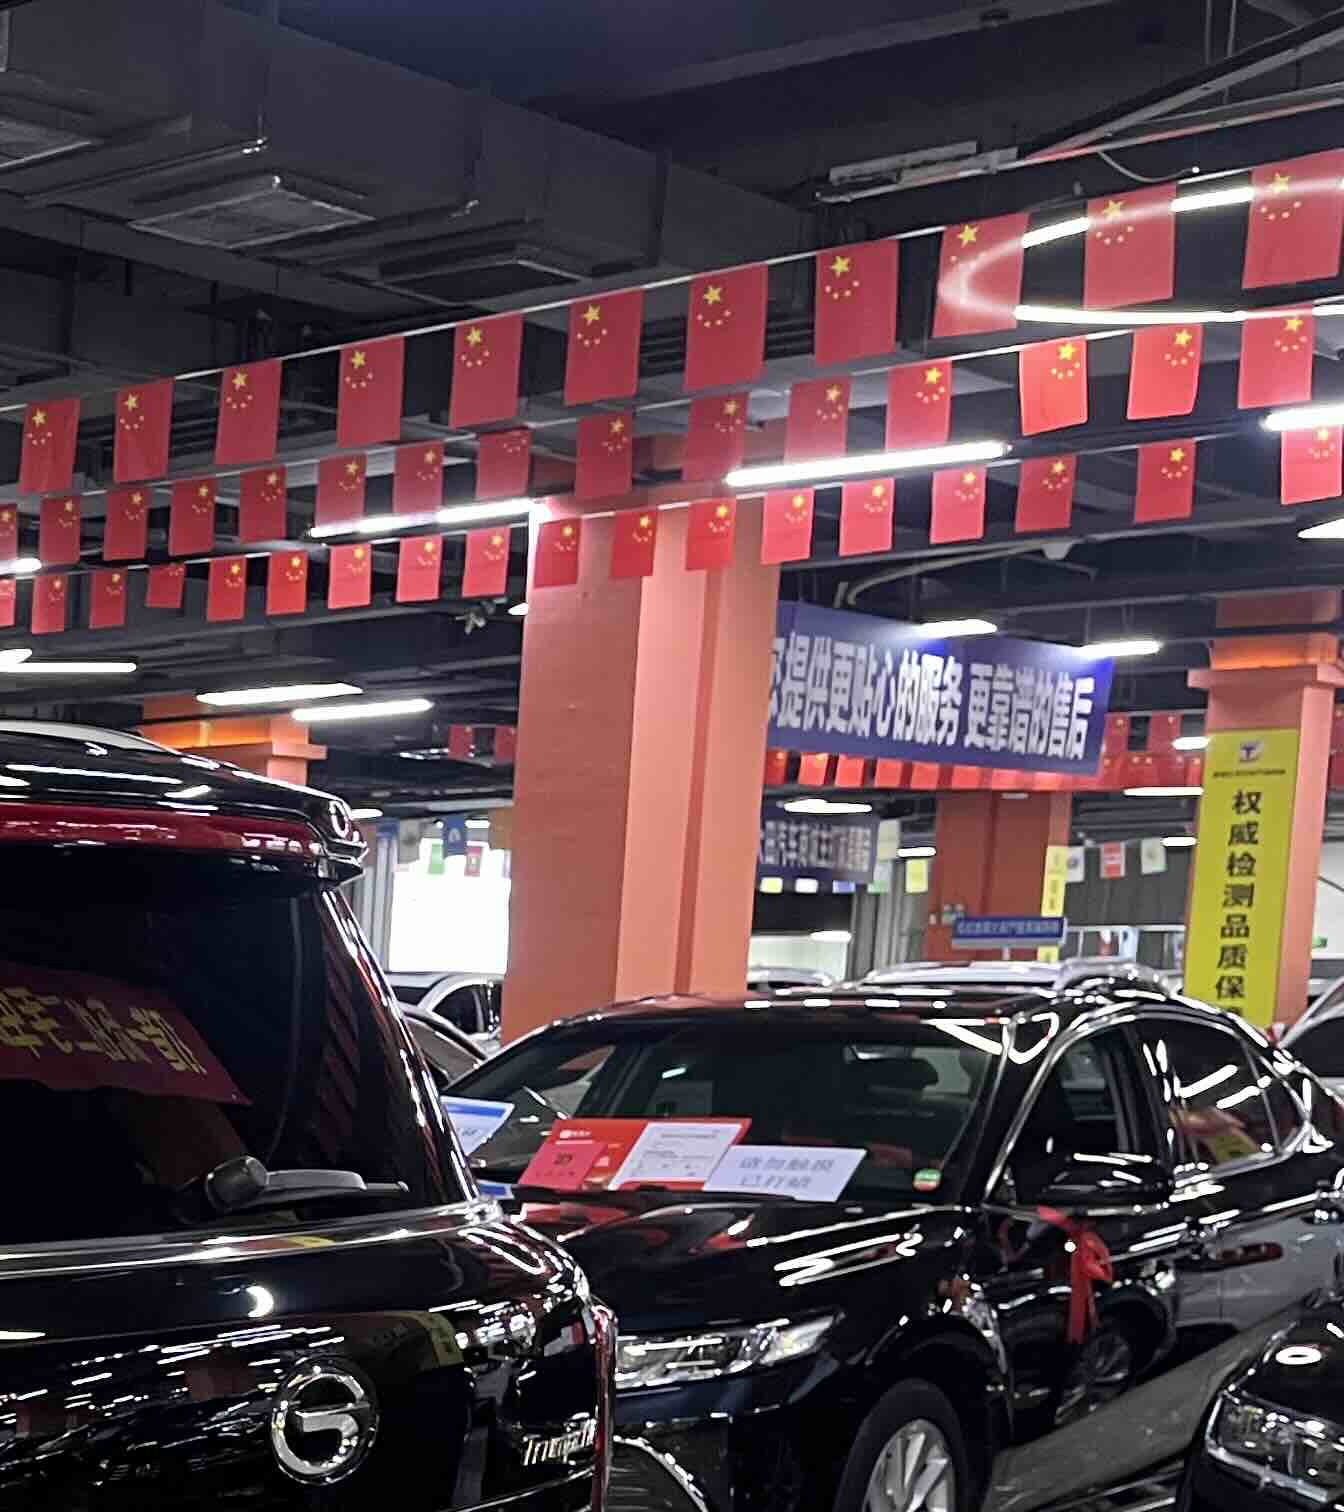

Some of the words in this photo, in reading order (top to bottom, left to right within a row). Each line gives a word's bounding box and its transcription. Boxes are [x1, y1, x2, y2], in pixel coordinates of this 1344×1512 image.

[964, 663, 1095, 761] 更靠谱的售后
